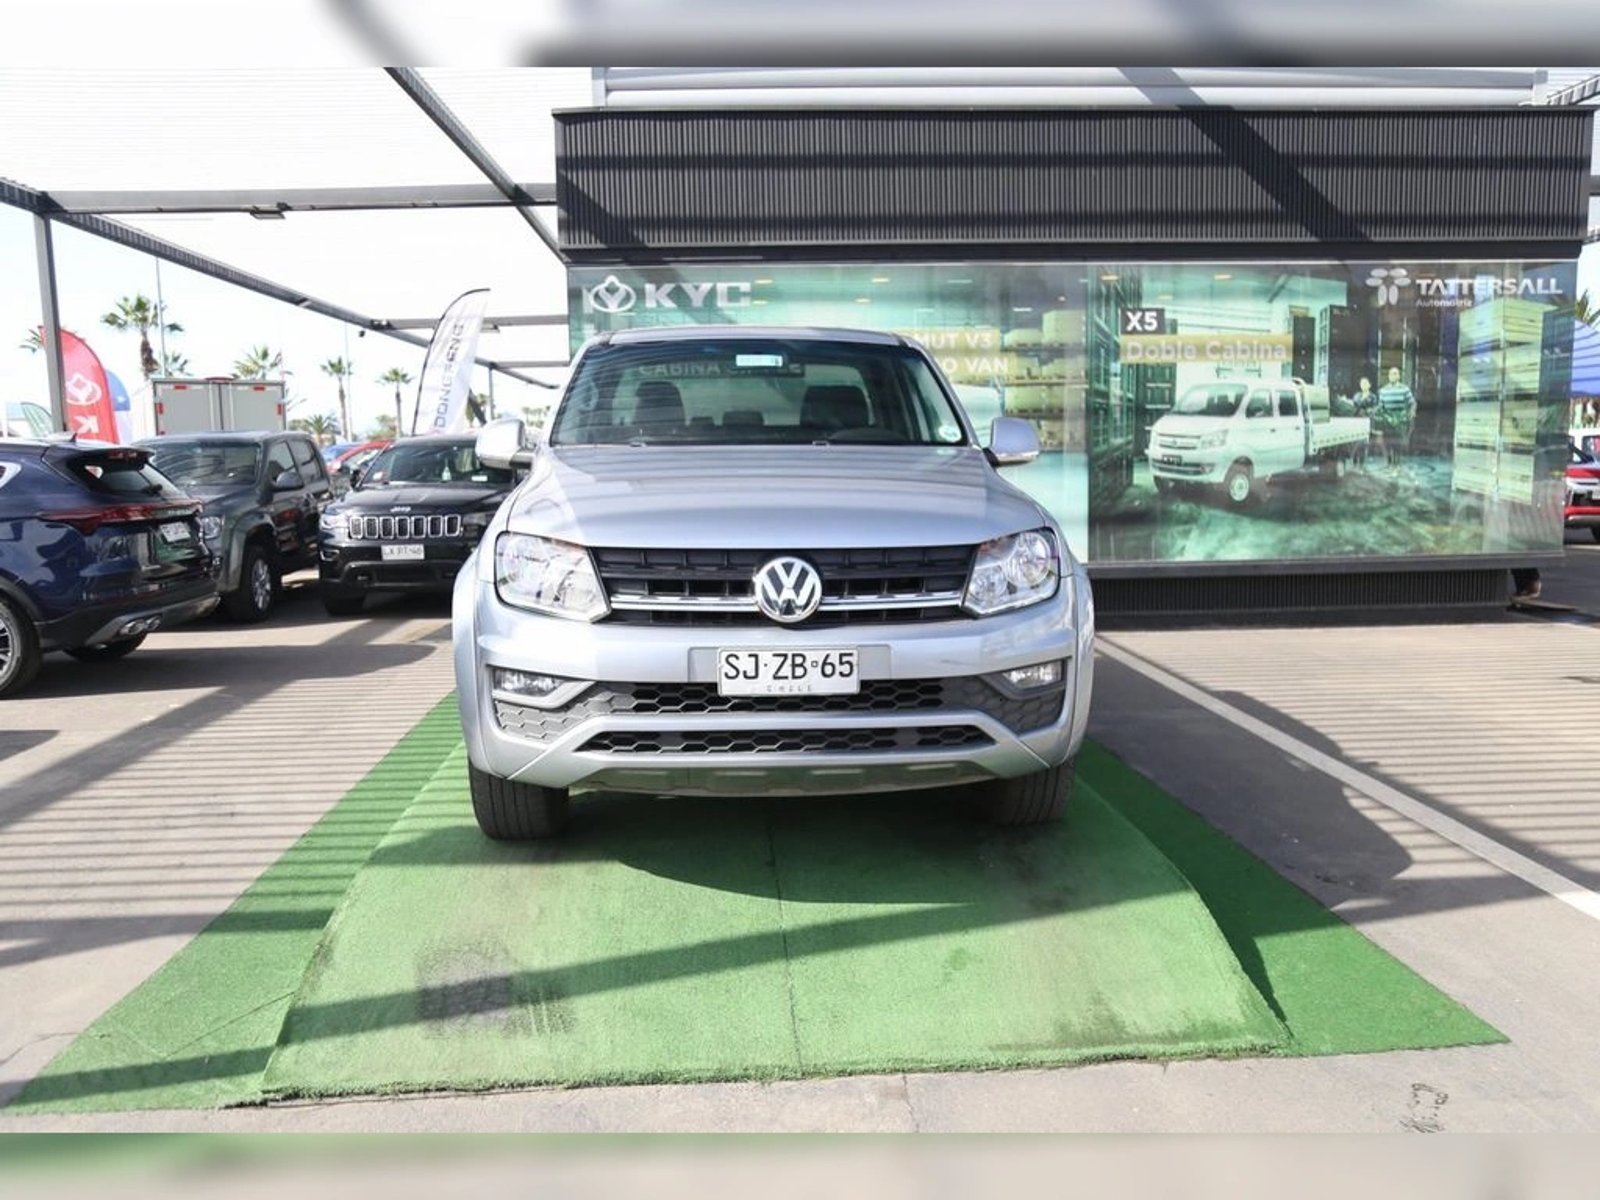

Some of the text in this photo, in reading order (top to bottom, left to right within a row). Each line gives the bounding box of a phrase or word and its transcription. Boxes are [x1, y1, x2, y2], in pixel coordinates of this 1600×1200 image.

[644, 282, 752, 309] KYC
[1415, 278, 1563, 295] TATTERSALL
[1125, 311, 1158, 332] X5
[964, 331, 992, 349] V3
[1126, 340, 1287, 360] Doble Cabina
[963, 357, 1009, 374] VAN
